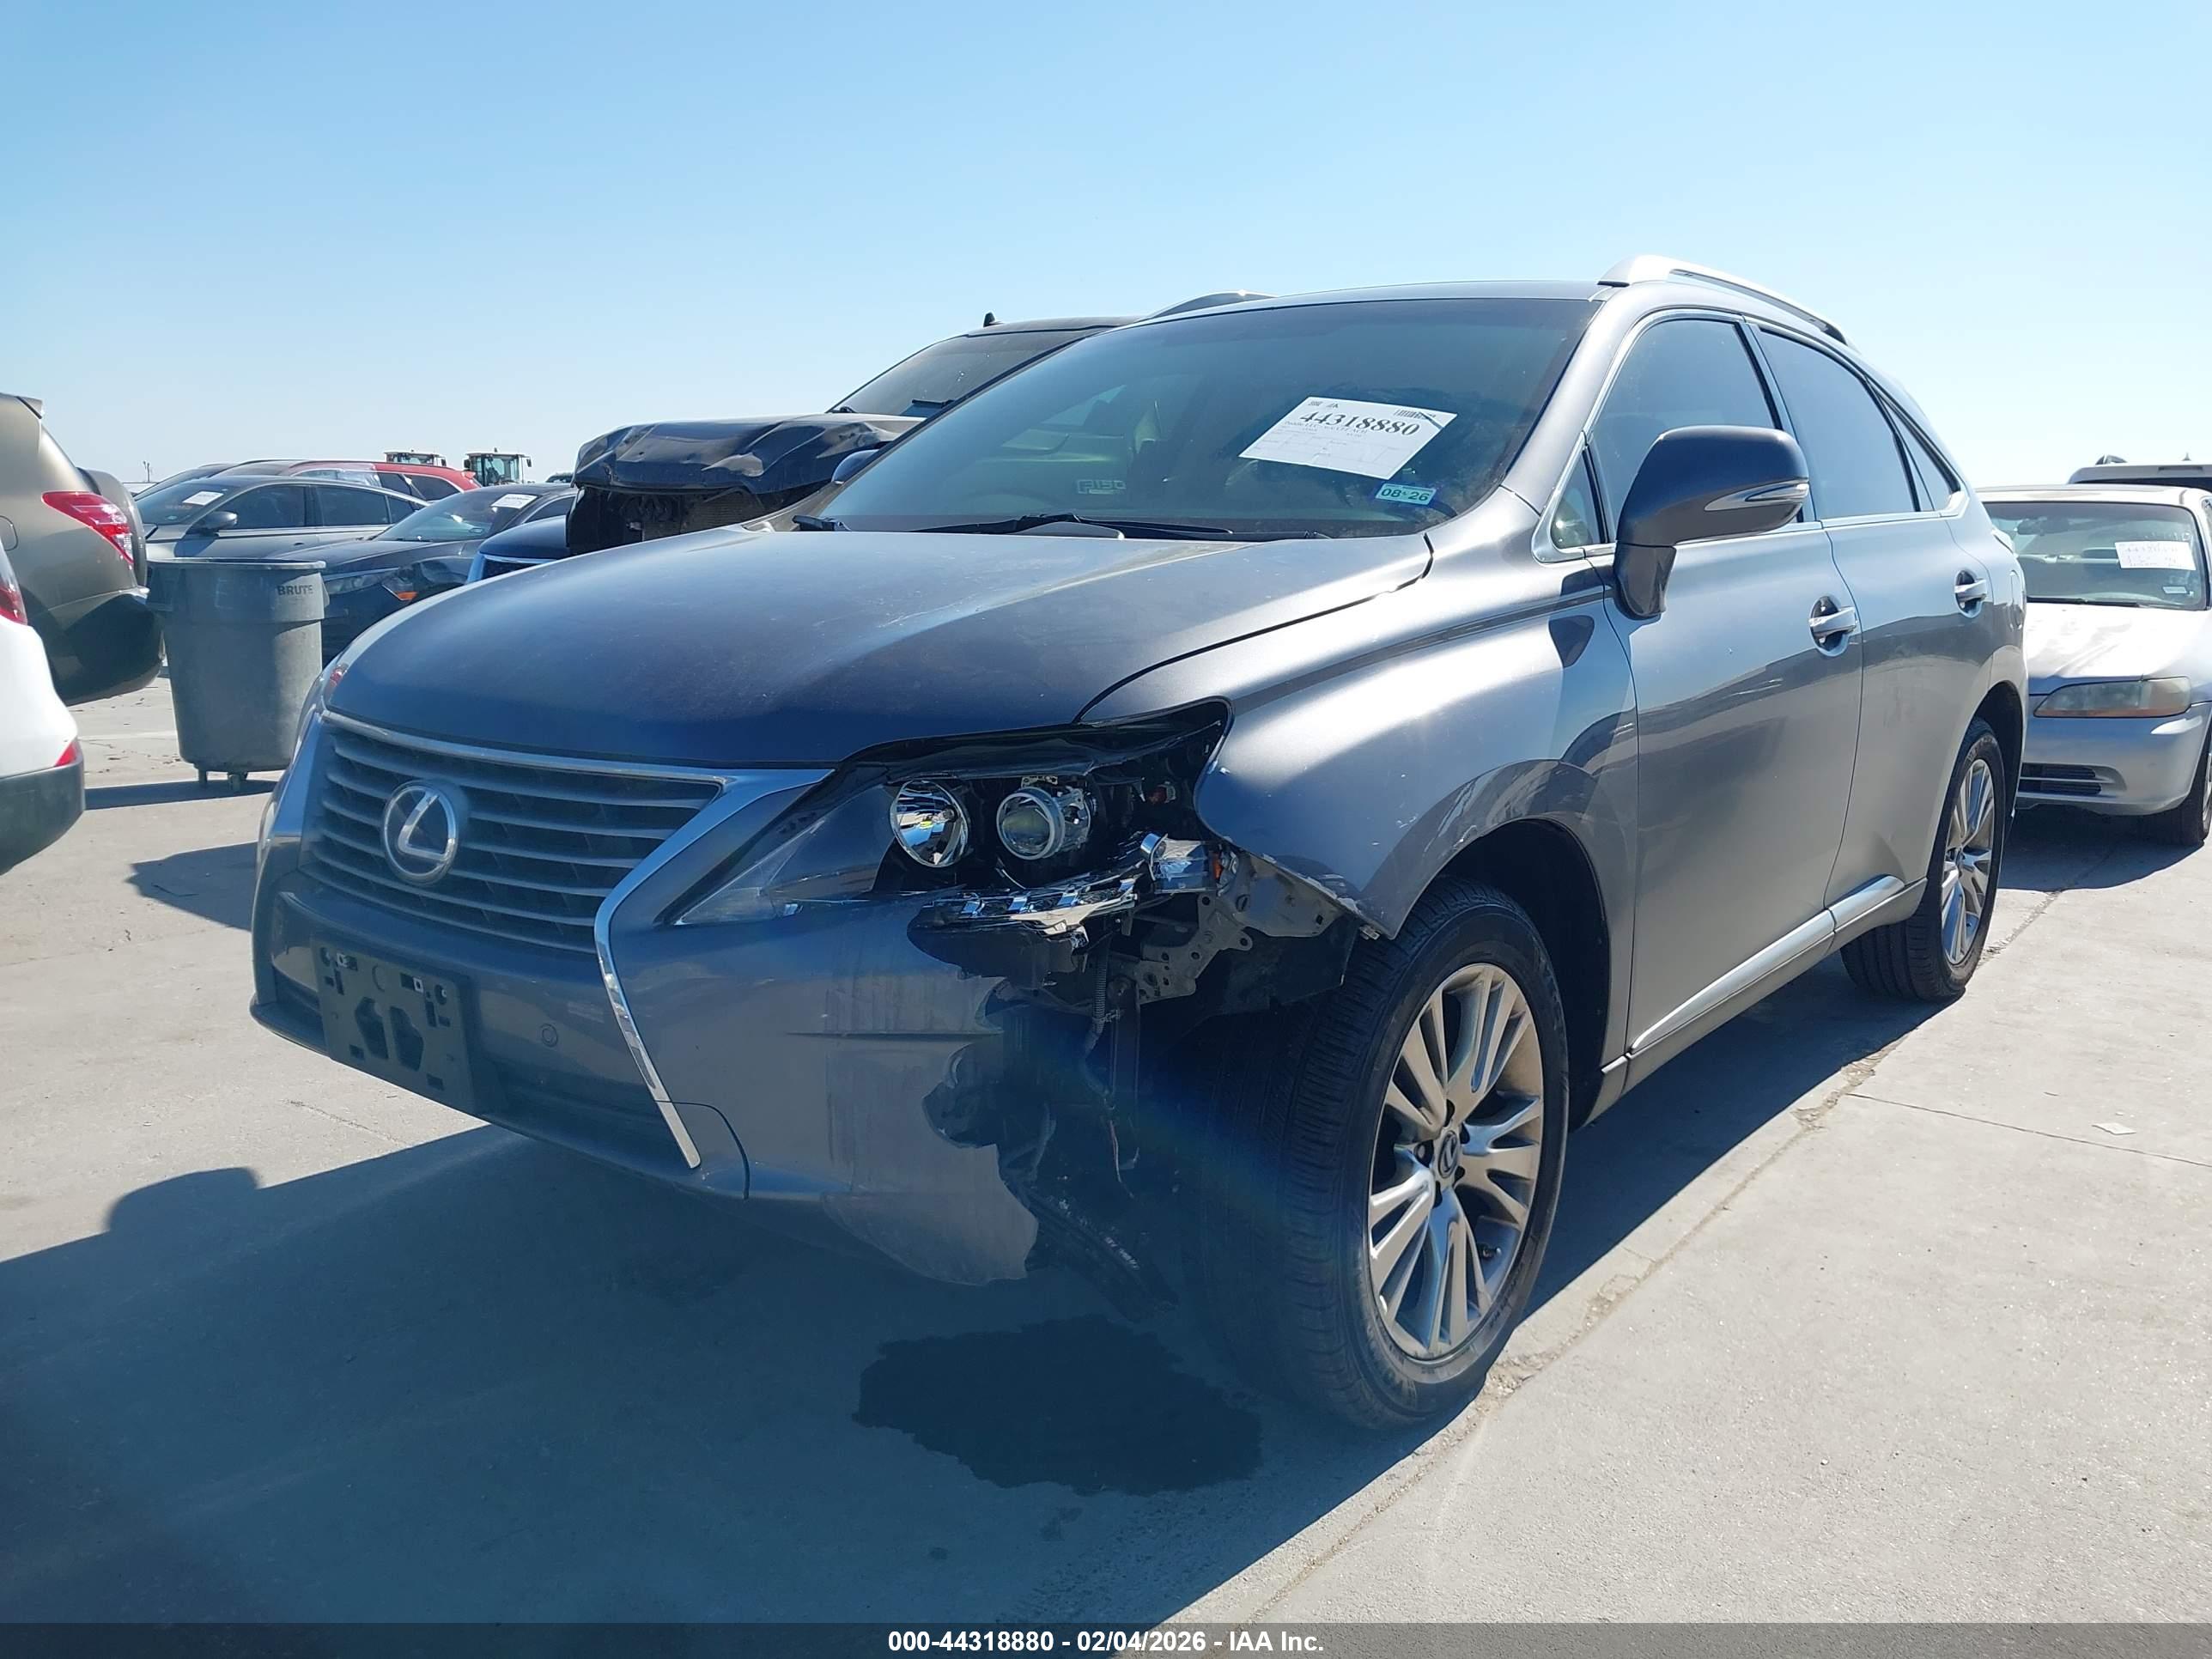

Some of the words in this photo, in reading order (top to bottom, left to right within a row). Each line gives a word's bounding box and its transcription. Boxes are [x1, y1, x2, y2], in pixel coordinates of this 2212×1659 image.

[1299, 410, 1421, 436] 44318880
[1381, 488, 1402, 498] 08
[1407, 491, 1430, 501] 26
[276, 584, 314, 596] BRUTE
